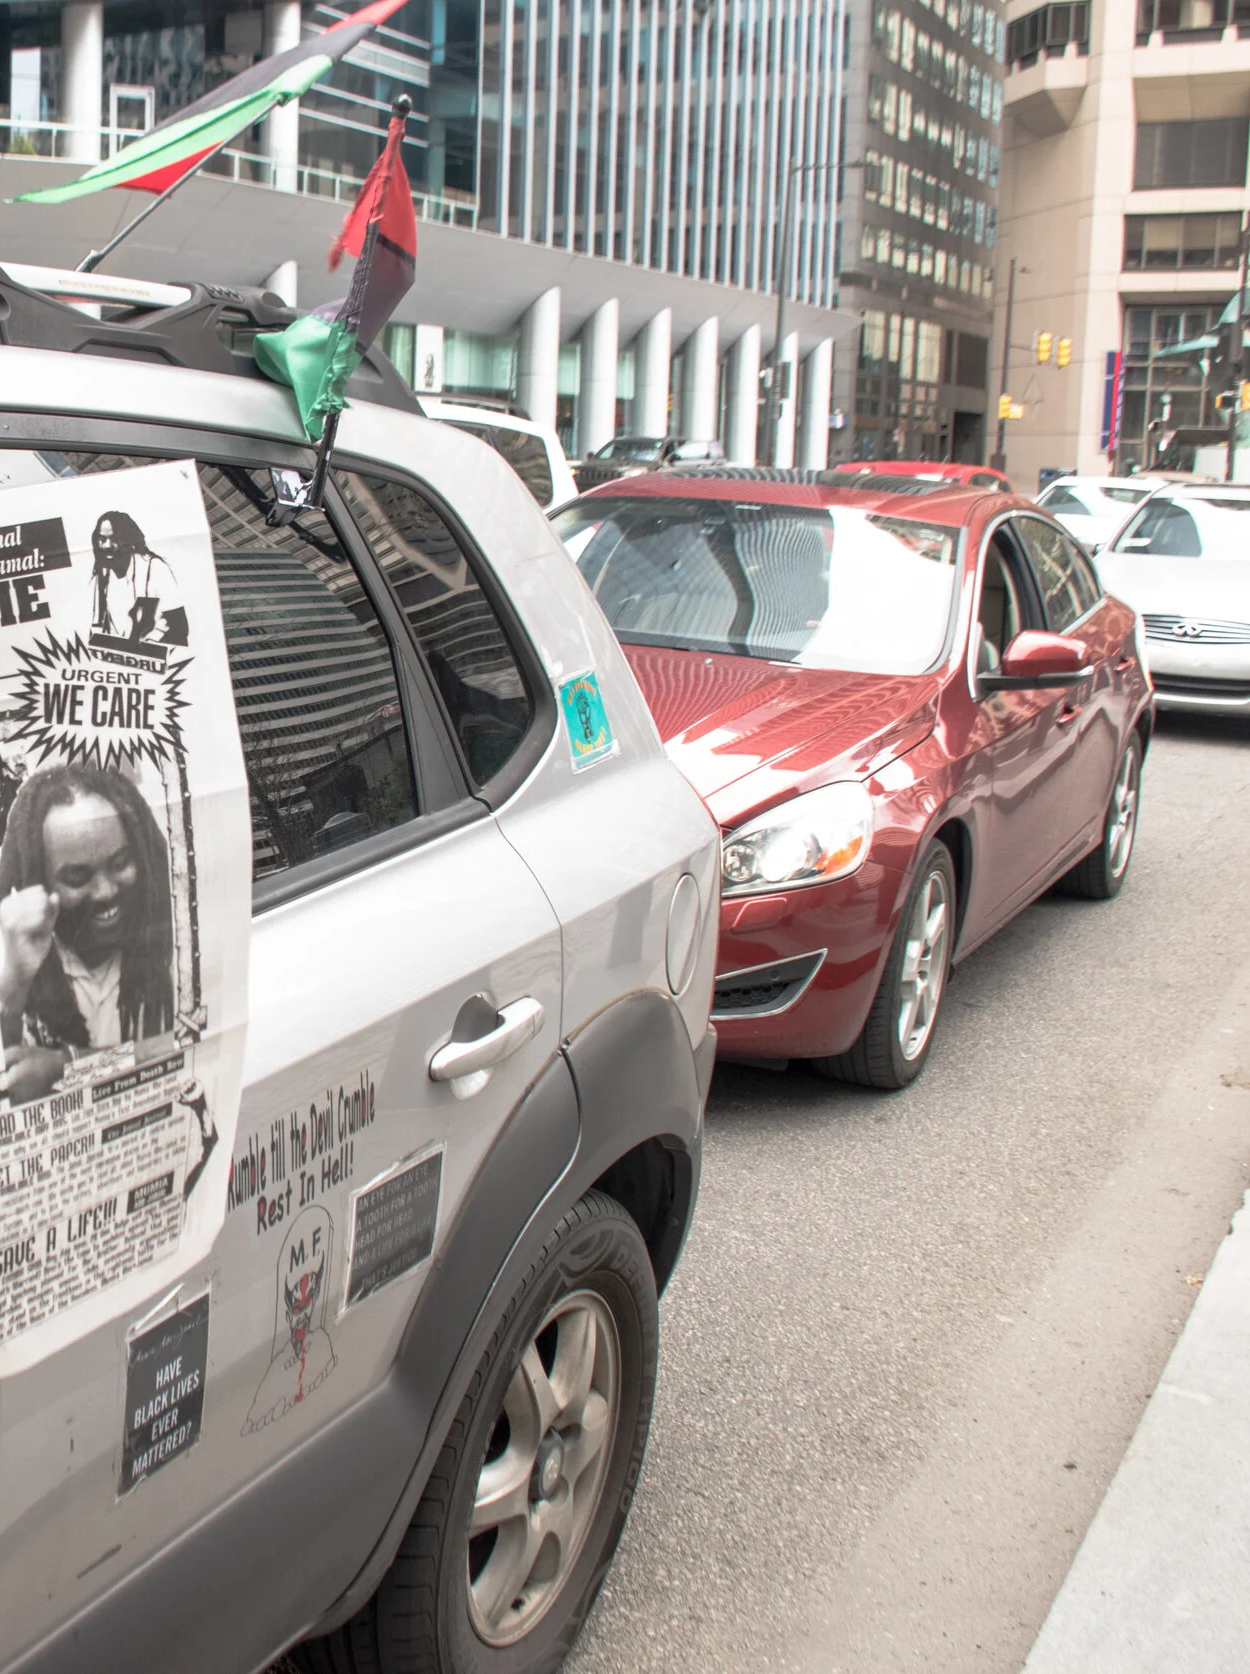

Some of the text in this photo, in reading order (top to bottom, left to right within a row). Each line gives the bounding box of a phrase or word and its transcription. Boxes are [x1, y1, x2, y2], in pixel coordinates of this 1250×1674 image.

[61, 669, 142, 685] URGENT
[43, 683, 155, 730] WE CARE
[22, 1102, 45, 1128] THE
[50, 1088, 83, 1118] BOOK!
[20, 1153, 42, 1179] THE
[50, 1132, 95, 1167] PAPER!!
[228, 1132, 266, 1212] Rumble
[271, 1118, 285, 1184] till
[291, 1110, 307, 1172] the
[310, 1088, 334, 1161] Devil
[338, 1068, 375, 1143] Crumble
[257, 1140, 354, 1236] Rest In Hell!
[45, 1225, 56, 1253] A
[66, 1196, 117, 1244] LIFE!!!
[155, 1355, 183, 1390] HAVE
[134, 1370, 200, 1429] BLACK LIVES
[151, 1407, 179, 1442] EVER
[132, 1422, 192, 1478] MATTERED?
